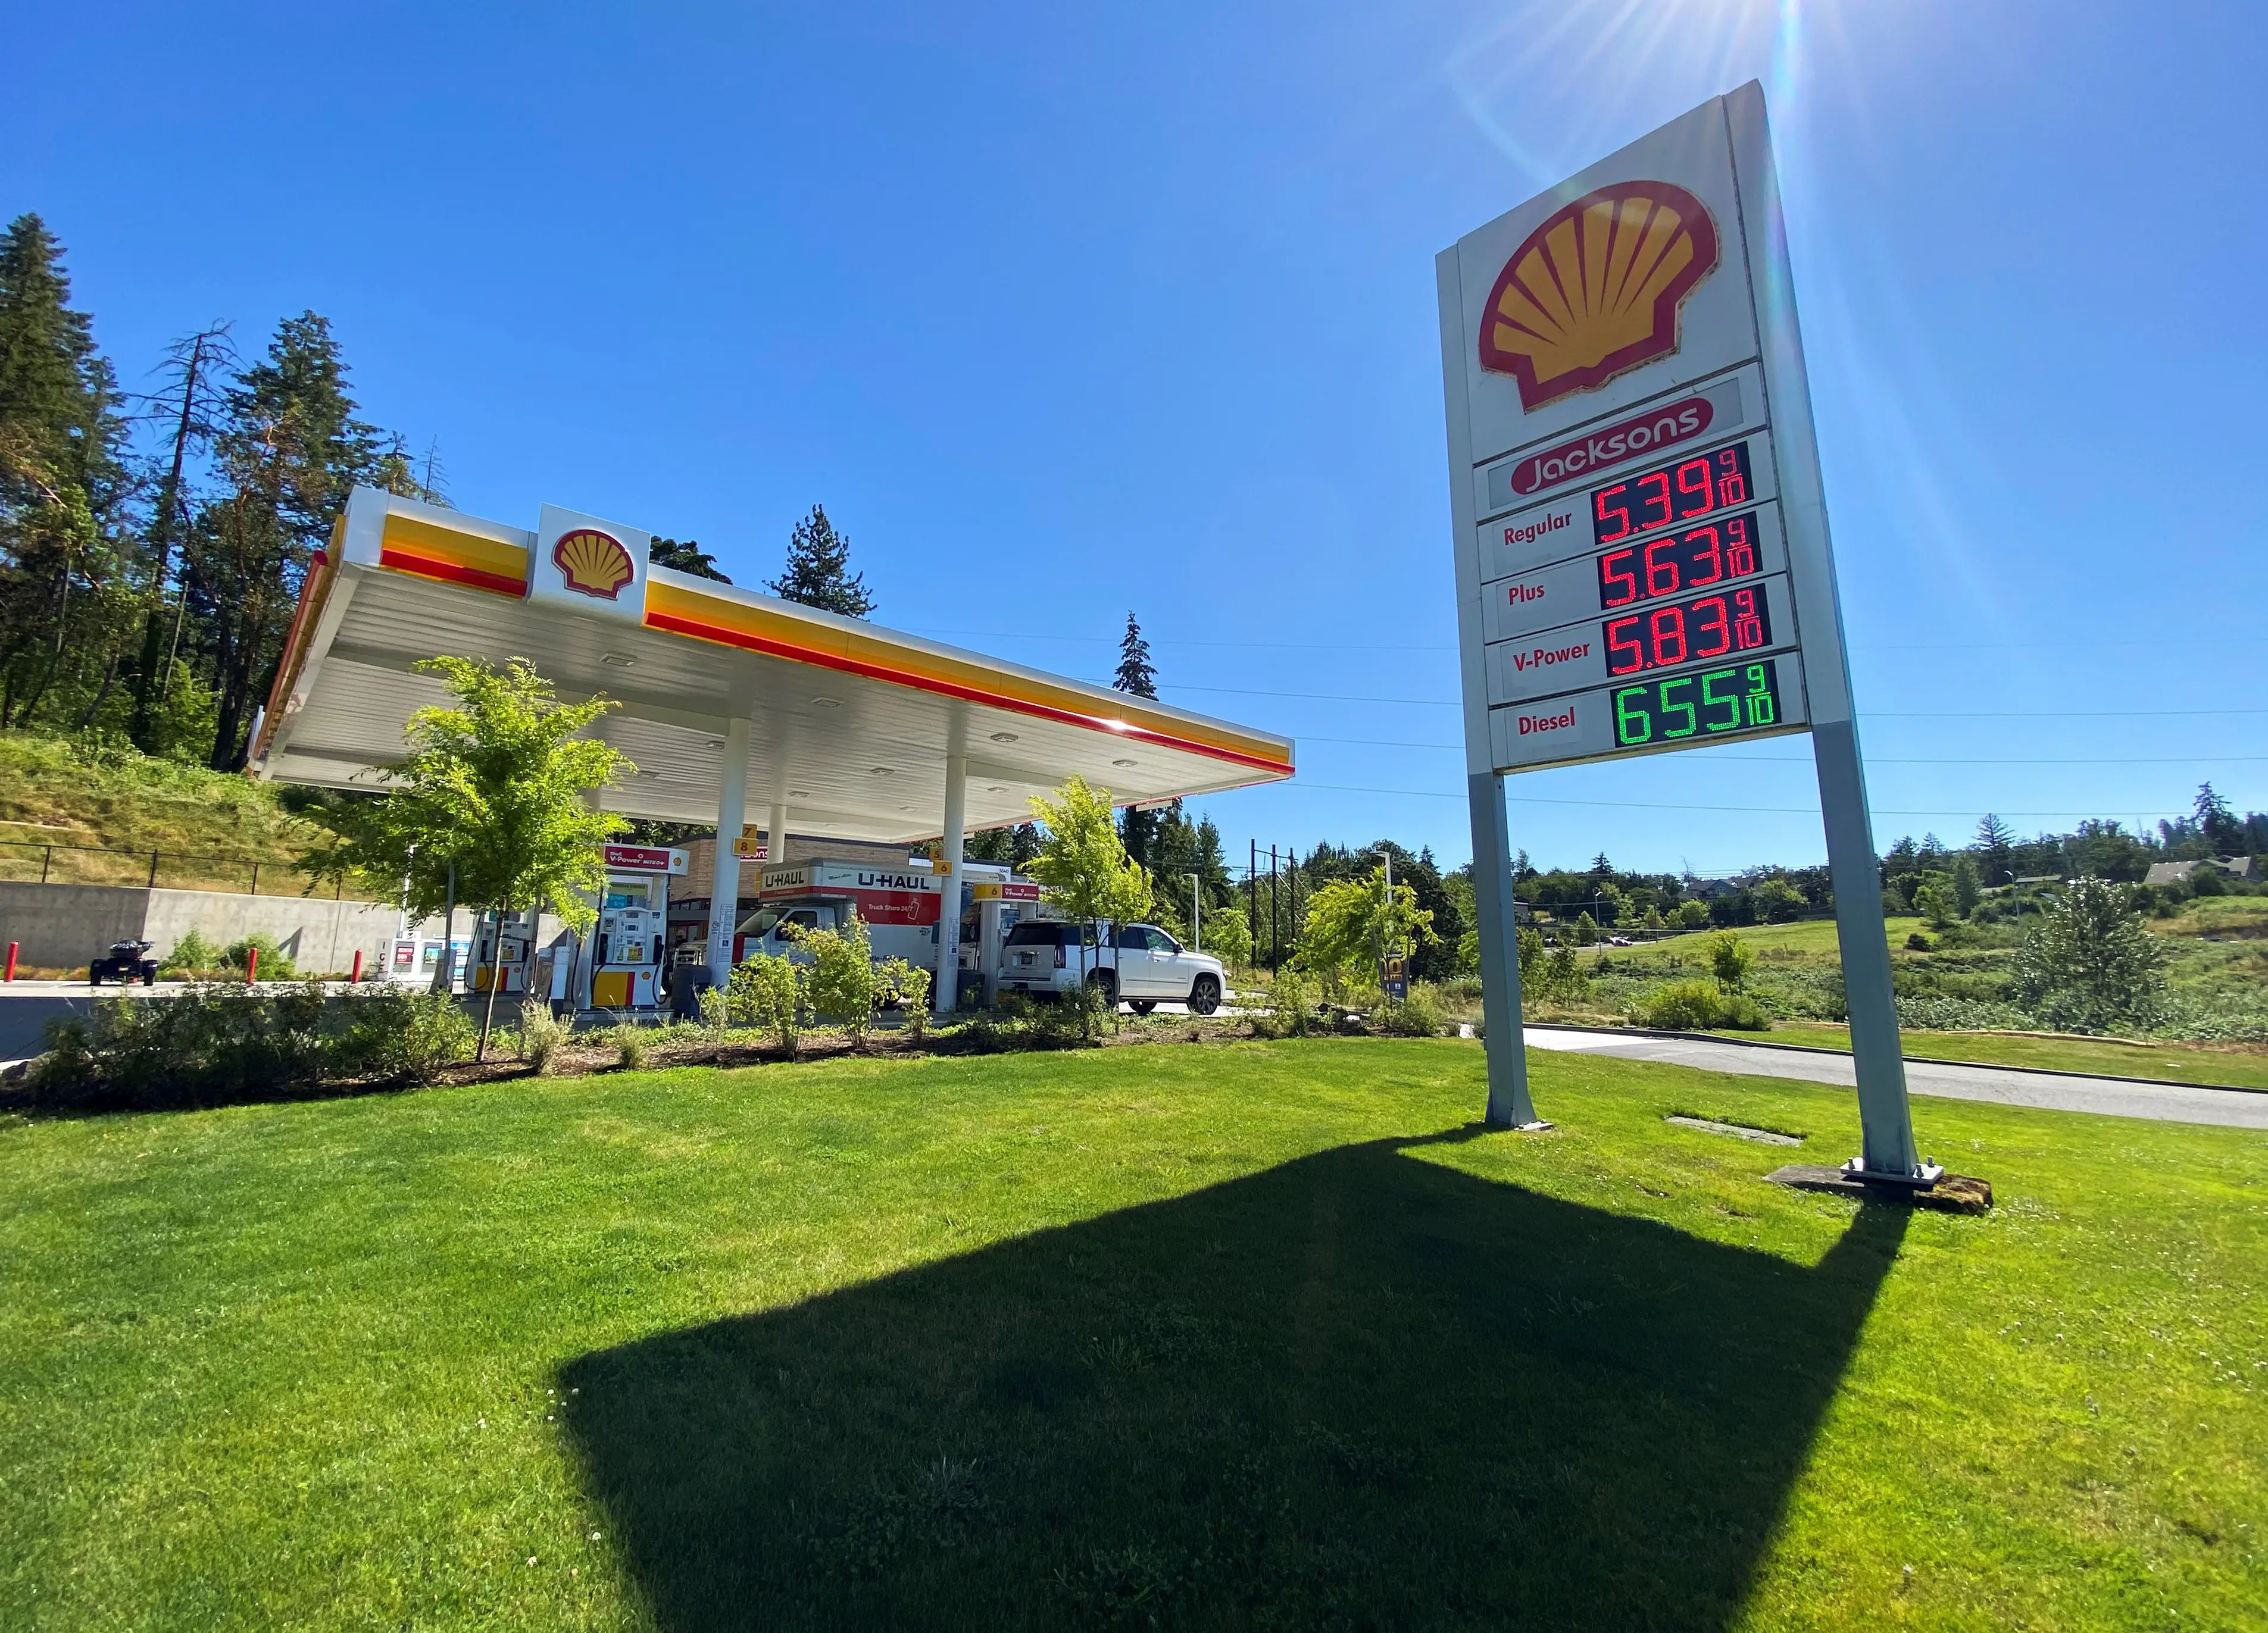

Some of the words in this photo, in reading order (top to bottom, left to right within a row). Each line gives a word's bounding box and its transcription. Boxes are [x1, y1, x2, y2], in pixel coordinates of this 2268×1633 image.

[1526, 408, 1700, 493] Jacksons
[1597, 458, 1714, 542] 5.39
[1504, 513, 1572, 546] Regular
[1602, 526, 1722, 606] 5.63
[1508, 584, 1545, 605] Plus
[1608, 596, 1730, 675] 5.83
[1513, 642, 1591, 672] V-Power
[1519, 706, 1576, 736] Diesel
[744, 827, 753, 836] 7
[740, 842, 748, 852] 8
[933, 850, 940, 859] 5
[941, 864, 948, 872] 6
[766, 871, 804, 887] U-HAUL
[858, 872, 930, 890] U-HAUL
[901, 905, 913, 914] 24/7
